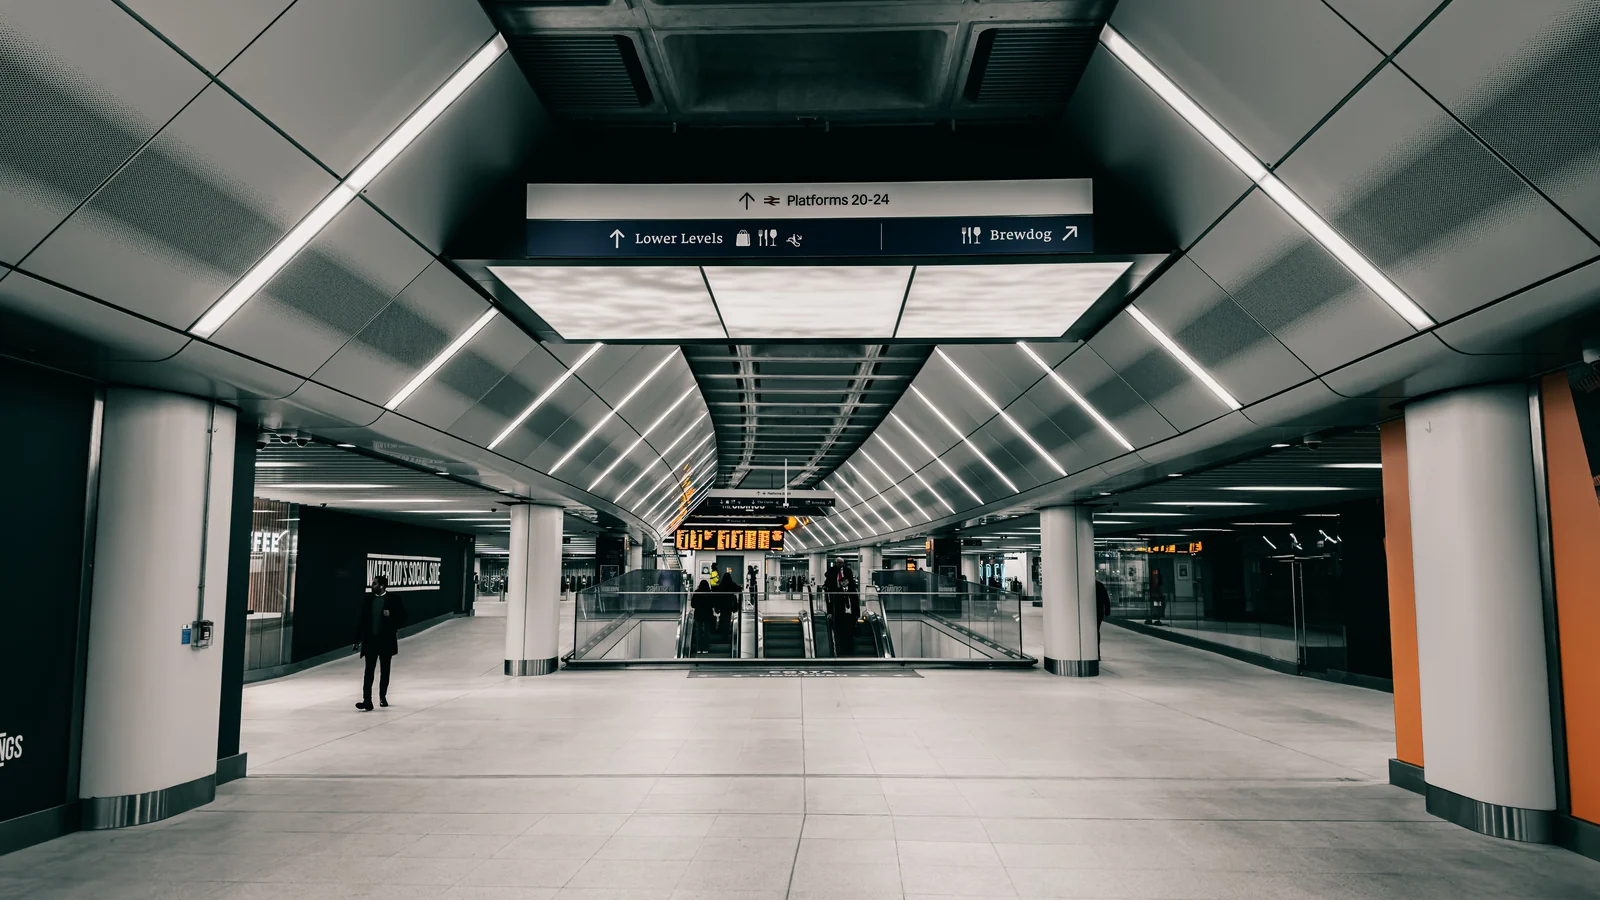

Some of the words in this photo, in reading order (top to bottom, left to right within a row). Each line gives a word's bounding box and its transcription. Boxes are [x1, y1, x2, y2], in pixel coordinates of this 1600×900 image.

[787, 194, 849, 206] Platforms
[851, 193, 890, 206] 20-24
[635, 233, 677, 244] Lower
[681, 233, 723, 244] Levels
[990, 229, 1052, 243] Brewdog
[408, 561, 428, 585] SOCIAL
[429, 562, 441, 584] SIDE
